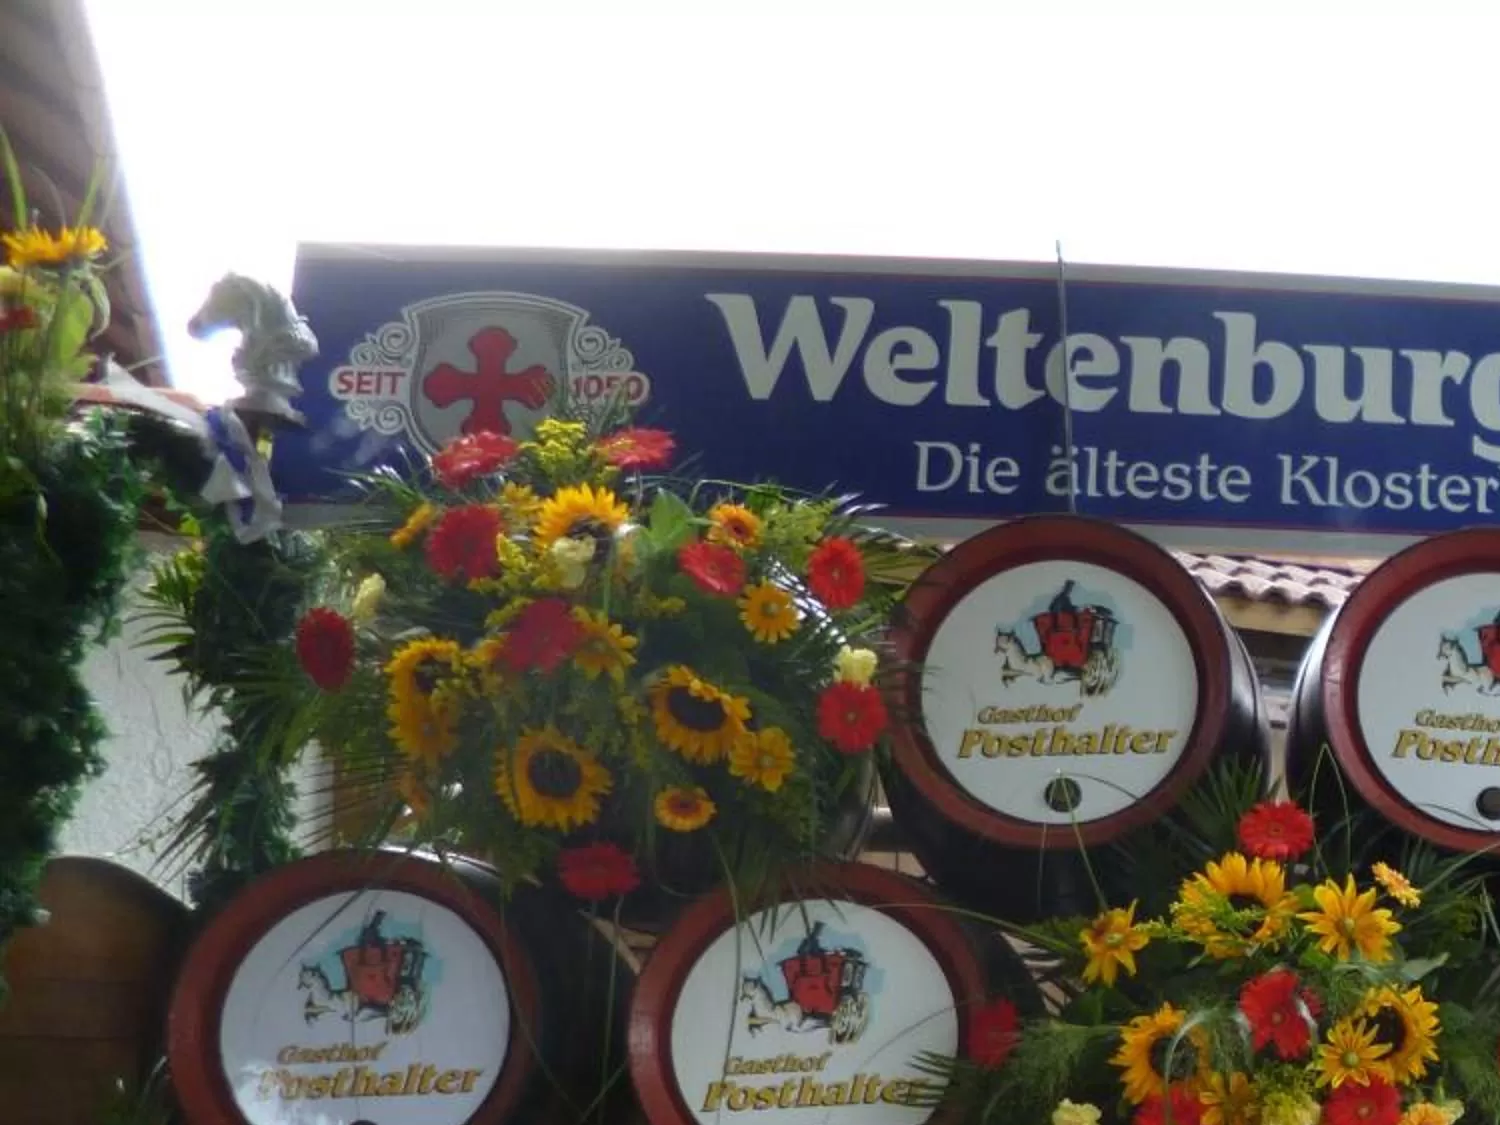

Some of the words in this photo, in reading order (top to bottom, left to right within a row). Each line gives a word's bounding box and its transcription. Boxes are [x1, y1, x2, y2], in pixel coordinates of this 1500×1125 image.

[337, 371, 406, 395] SEIT
[571, 375, 645, 401] 1050
[914, 441, 1019, 493] Die
[1046, 446, 1251, 502] älteste
[977, 703, 1083, 725] Gasthof
[957, 723, 1179, 759] Posthalter
[277, 1042, 388, 1065] Gasthof
